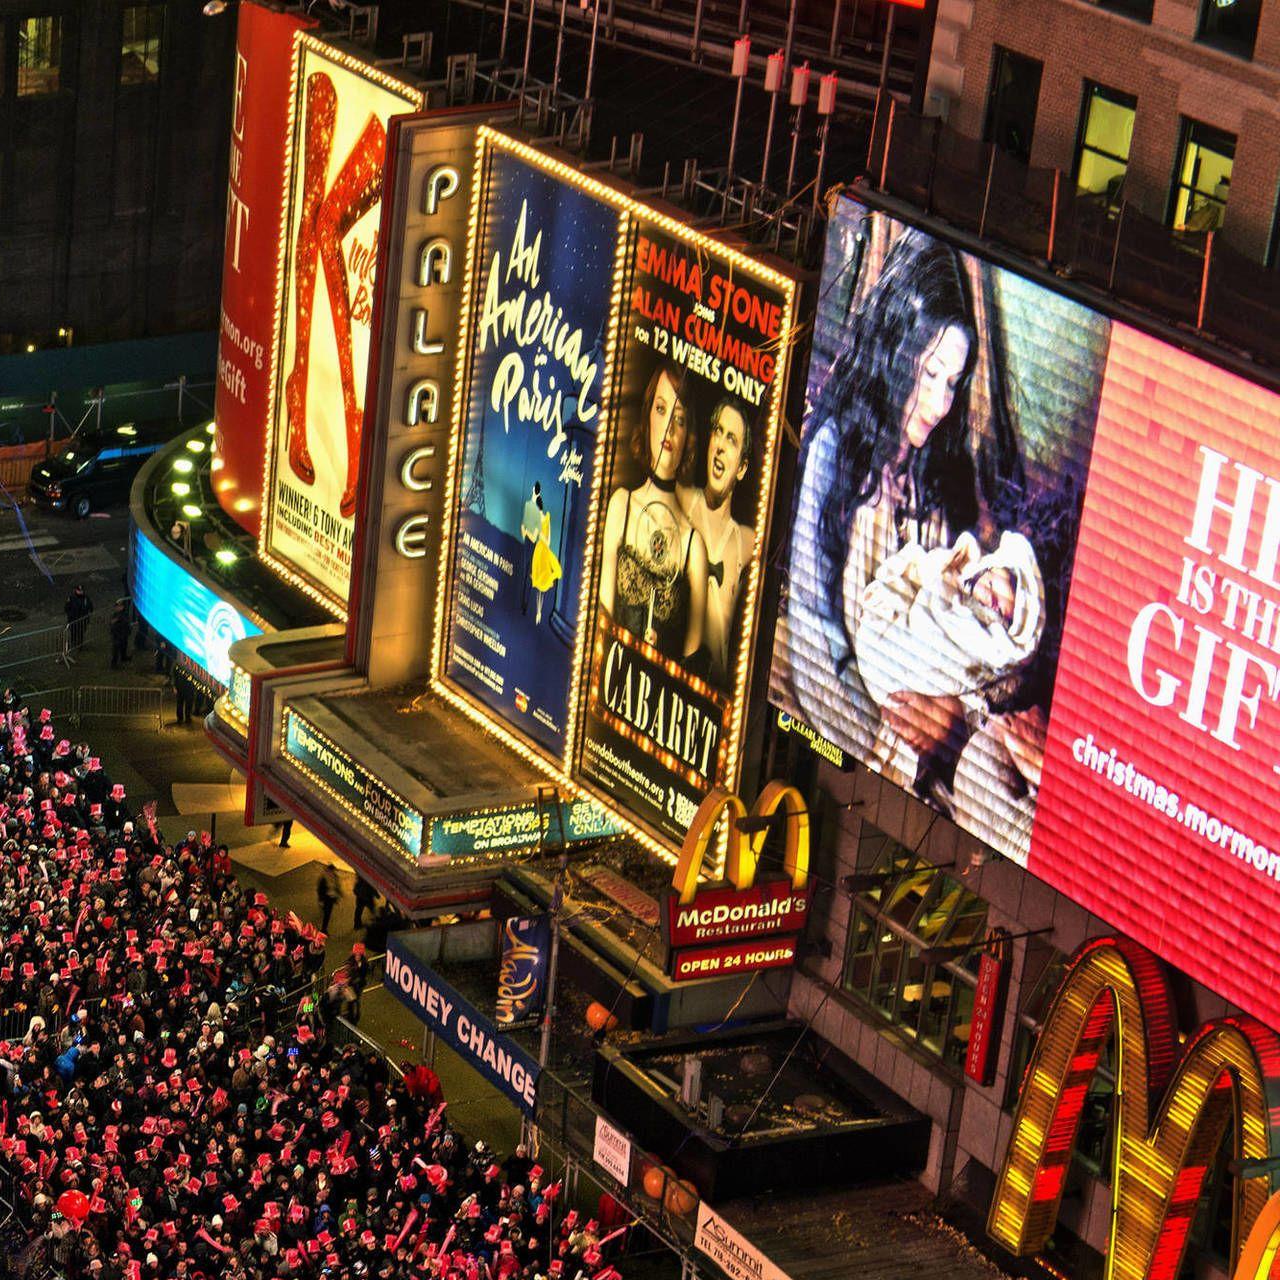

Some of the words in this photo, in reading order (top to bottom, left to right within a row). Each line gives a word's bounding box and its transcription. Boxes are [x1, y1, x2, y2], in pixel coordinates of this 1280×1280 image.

[505, 198, 542, 290] An
[636, 236, 701, 300] EMMA
[708, 274, 781, 340] STONE
[394, 163, 460, 560] PALACE
[478, 249, 598, 423] American
[533, 346, 548, 367] in
[630, 285, 680, 334] ALAN
[684, 313, 775, 383] CUMMING
[634, 325, 650, 345] FOR
[653, 325, 669, 355] 12
[672, 335, 721, 383] WEEKS
[723, 366, 766, 407] ONLY
[491, 351, 567, 459] Paris
[276, 503, 313, 538] INCLUDING
[314, 529, 335, 553] BEST
[278, 479, 313, 521] WINNER!
[313, 504, 320, 527] 6
[321, 509, 342, 543] TONY
[1176, 556, 1216, 615] IS
[604, 640, 718, 778] CABARET
[293, 721, 355, 786] TEMPTATIONS
[365, 780, 392, 814] FOUR
[363, 799, 374, 814] ON
[473, 839, 489, 850] ON
[676, 896, 807, 929] McDonald's
[695, 917, 783, 939] Restaurant
[680, 957, 721, 974] OPEN
[723, 955, 741, 968] 24
[745, 948, 794, 964] HOURS
[386, 949, 454, 1027] MONEY
[456, 1013, 536, 1108] CHANGE
[700, 1236, 711, 1251] TEL
[713, 1223, 763, 1276] Summit
